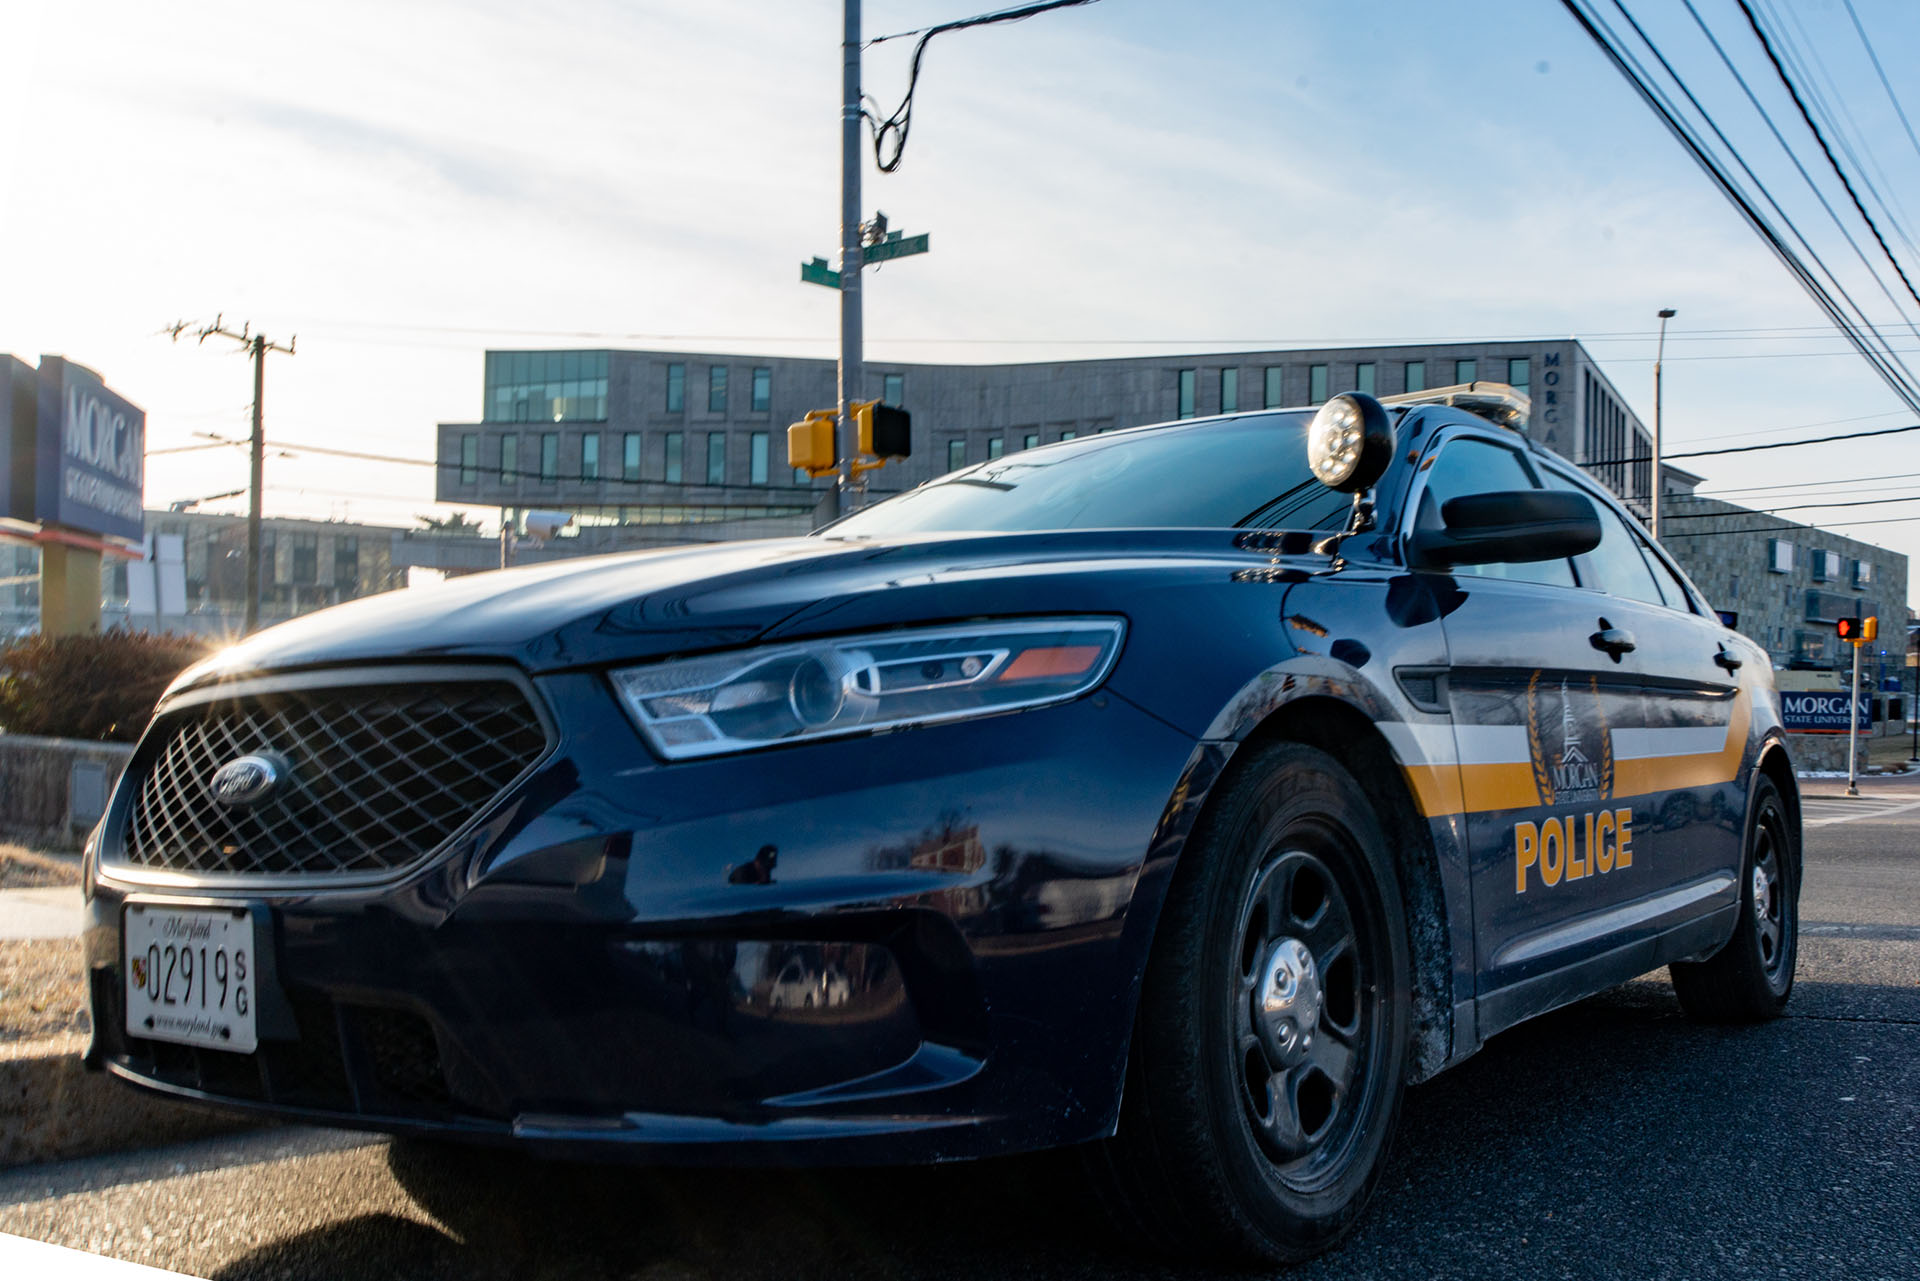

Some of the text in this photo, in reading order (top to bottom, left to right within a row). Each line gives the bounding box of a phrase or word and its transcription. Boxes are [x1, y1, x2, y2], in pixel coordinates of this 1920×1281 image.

[1543, 352, 1560, 453] MORGA
[1784, 696, 1870, 714] MORGAN
[1784, 714, 1869, 724] STATE UNIVERSTY
[1515, 808, 1632, 894] POLICE
[163, 915, 212, 941] Maryland
[147, 943, 228, 1010] 02919
